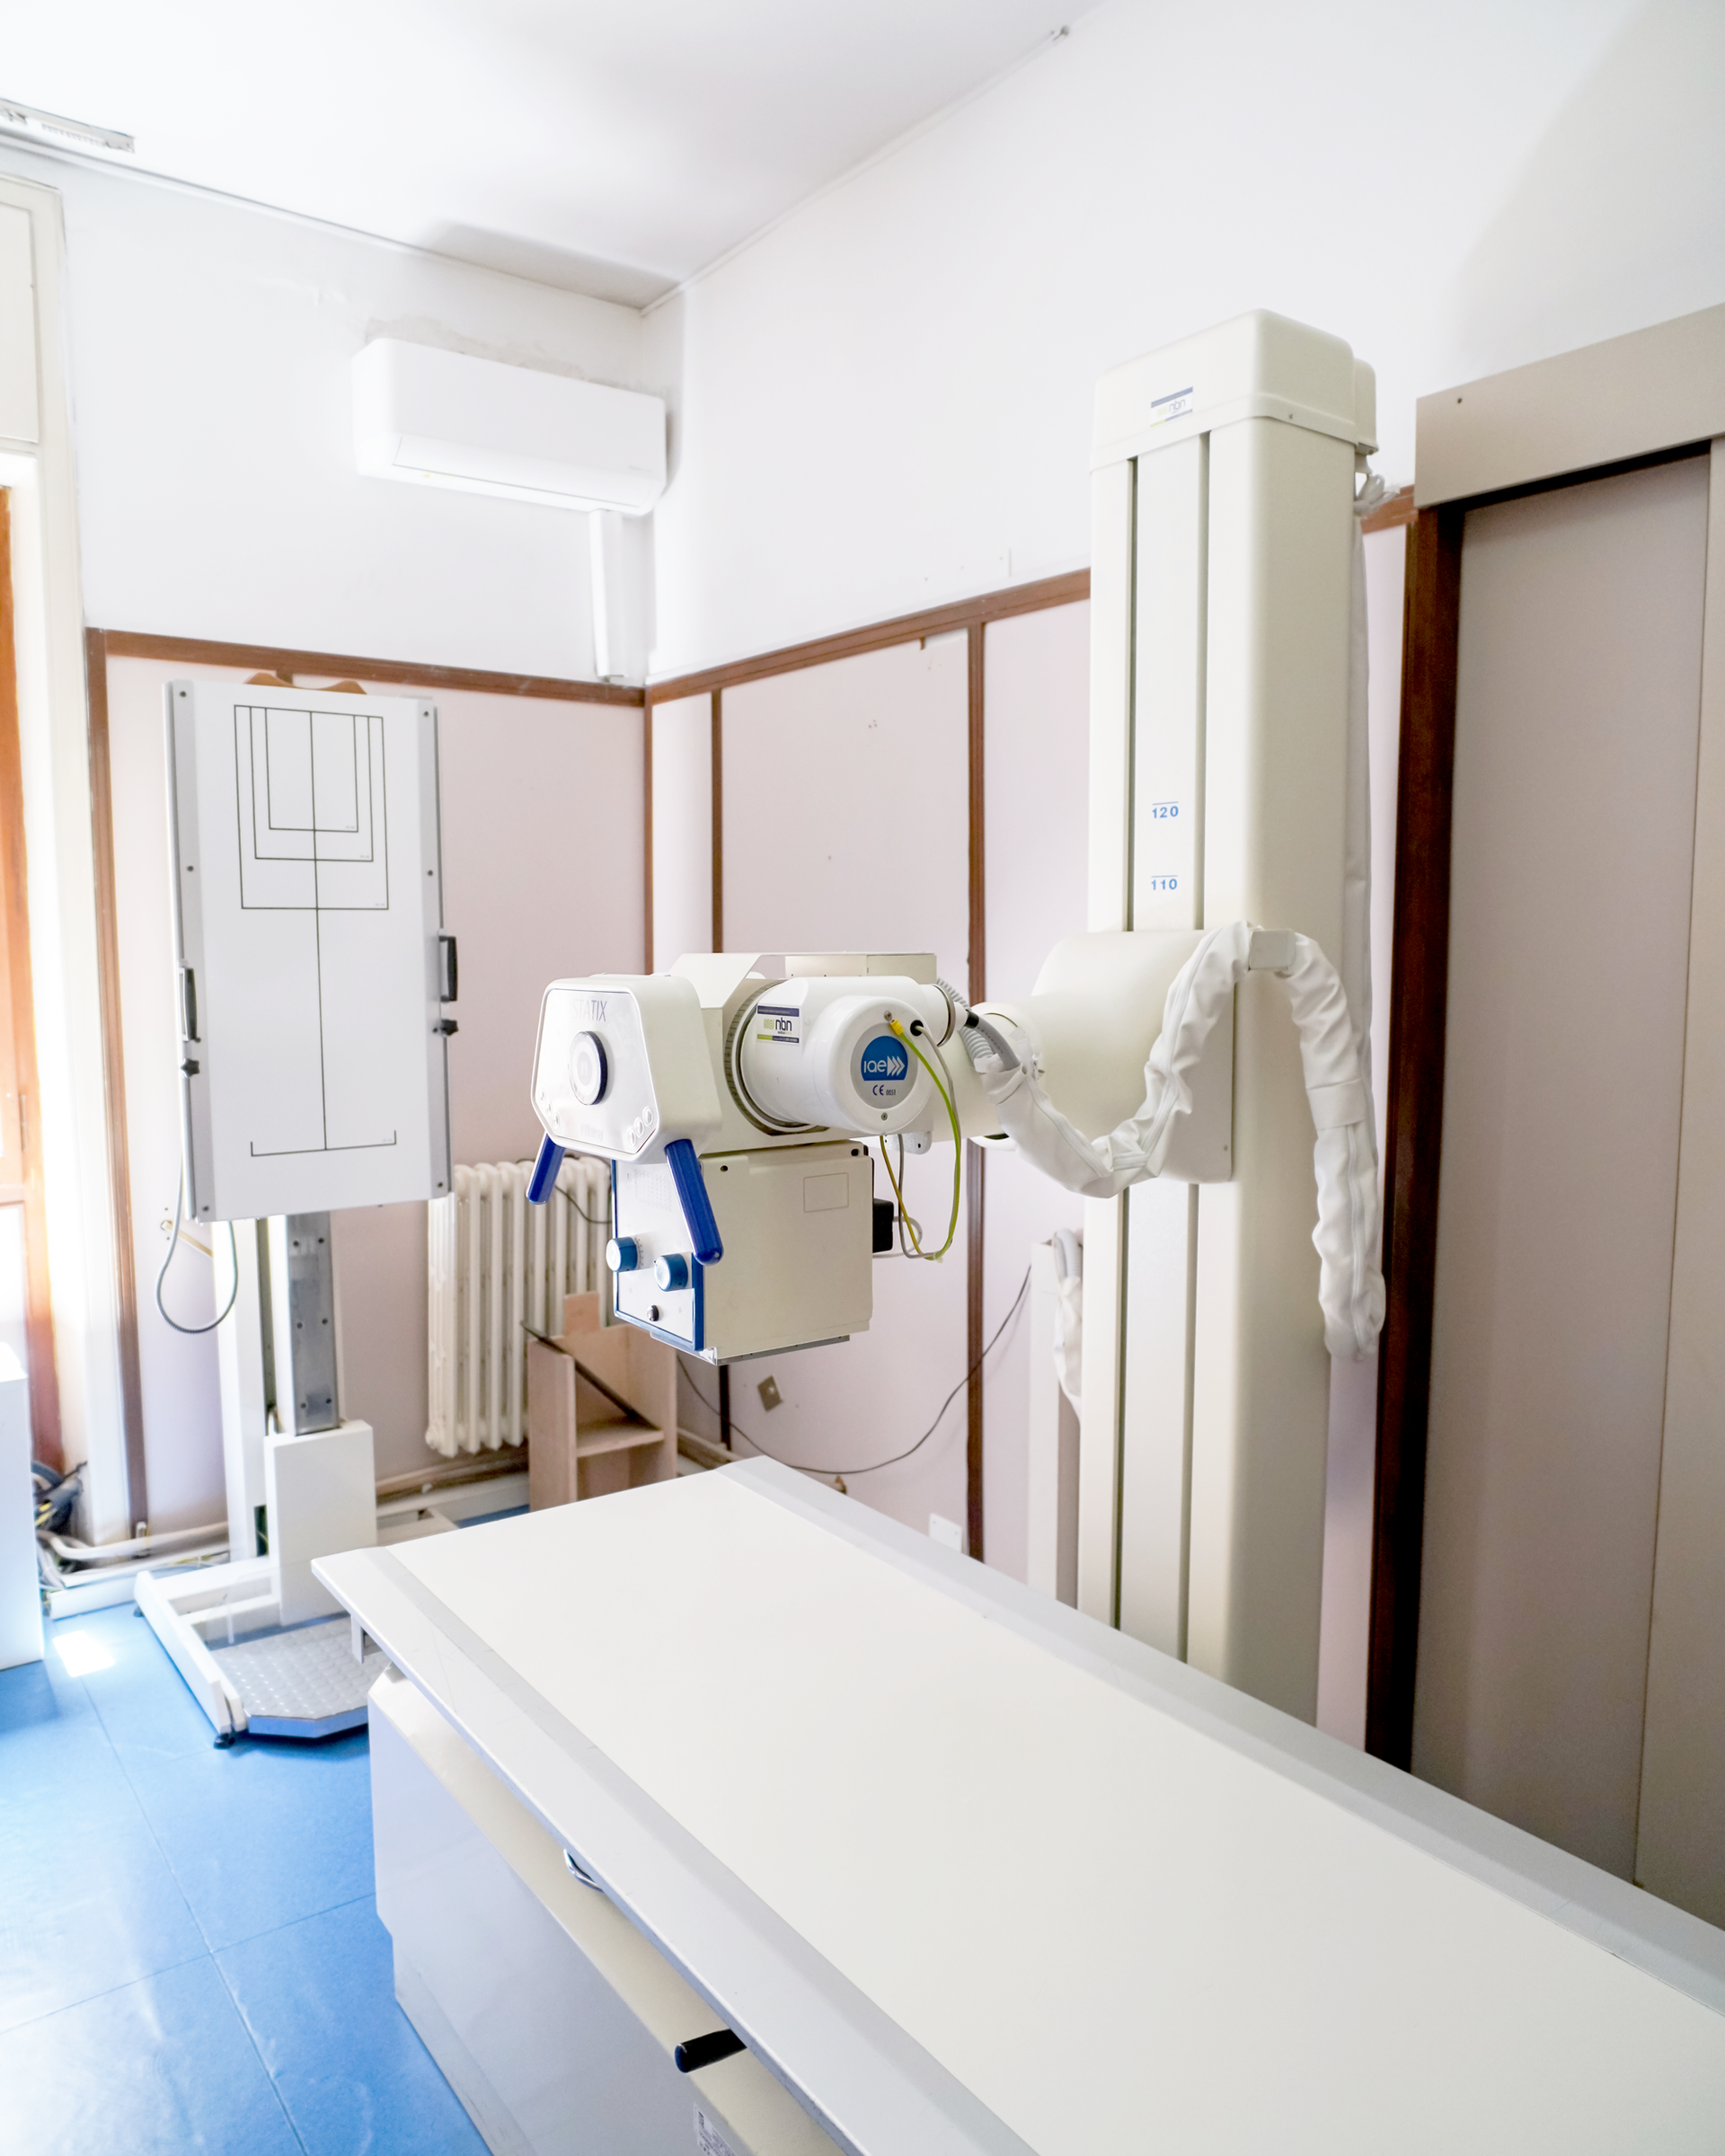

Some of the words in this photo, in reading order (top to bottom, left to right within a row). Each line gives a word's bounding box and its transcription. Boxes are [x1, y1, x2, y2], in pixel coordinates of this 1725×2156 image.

[1169, 399, 1186, 413] nbn
[1152, 806, 1179, 818] 120
[1151, 879, 1178, 890] 110
[571, 998, 607, 1022] STATIX
[775, 1017, 792, 1031] nbn
